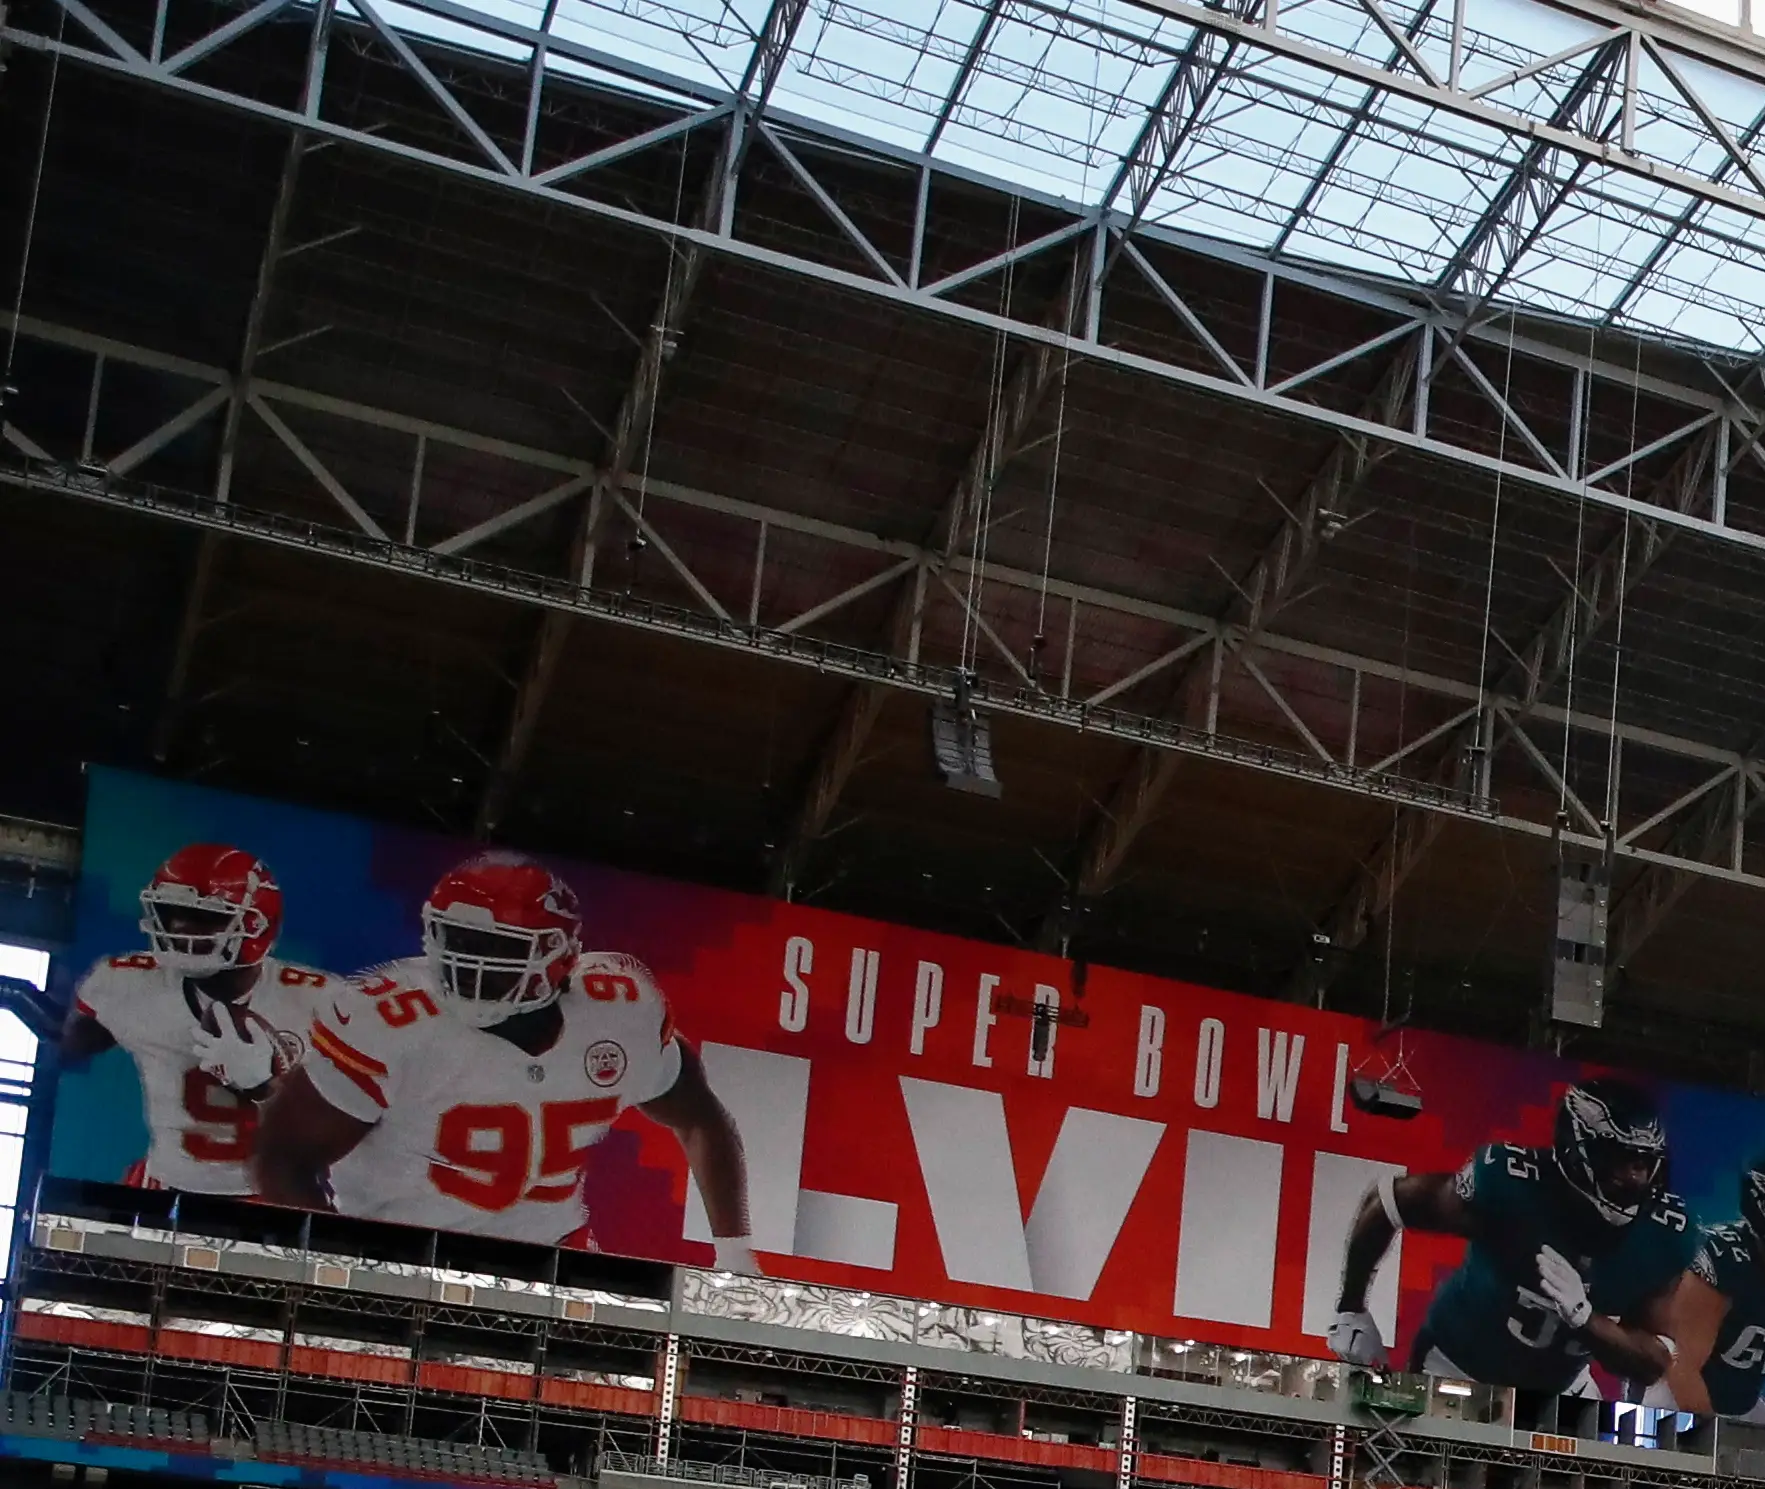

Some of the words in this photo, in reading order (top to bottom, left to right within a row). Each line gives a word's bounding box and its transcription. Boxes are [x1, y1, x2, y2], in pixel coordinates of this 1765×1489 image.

[779, 936, 1060, 1079] SUPER
[1132, 1004, 1349, 1134] BOWL
[428, 1096, 620, 1212] 95
[683, 1041, 1408, 1348] LVII
